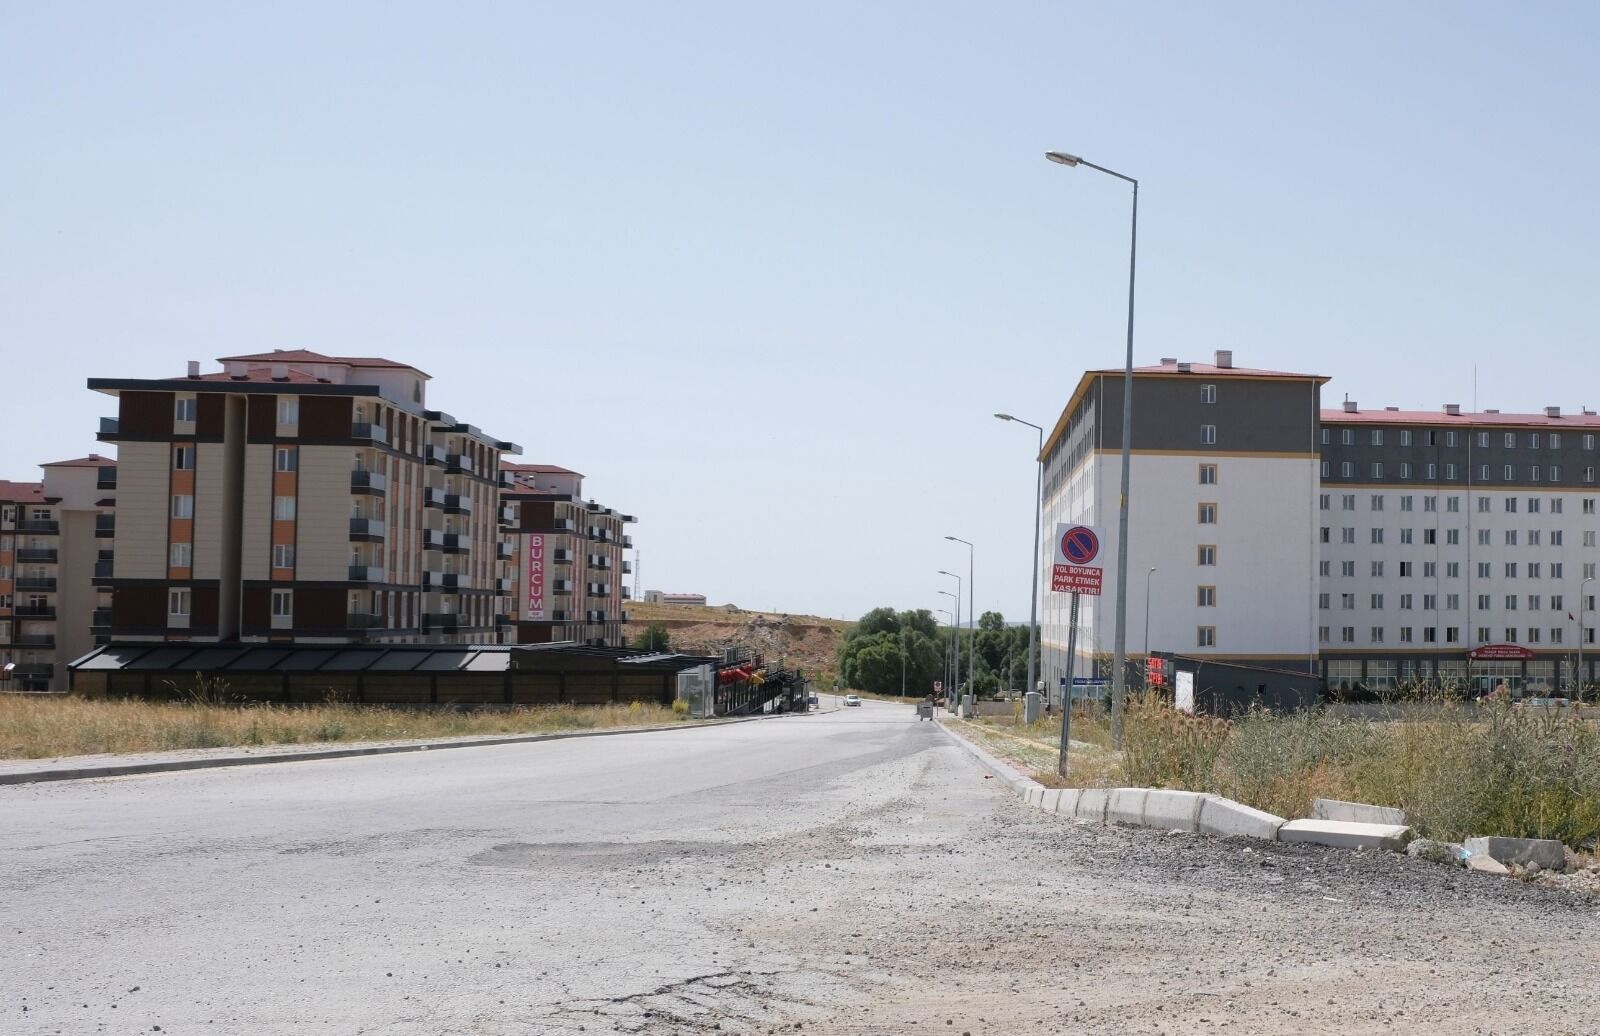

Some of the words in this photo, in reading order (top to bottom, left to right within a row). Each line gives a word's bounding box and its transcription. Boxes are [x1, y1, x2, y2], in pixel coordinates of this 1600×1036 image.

[529, 536, 543, 608] BURCUM
[1055, 565, 1069, 573] YOL
[1069, 567, 1101, 576] BOYUNCA
[1054, 575, 1074, 583] PARK
[1075, 577, 1100, 586] ETMEK
[1053, 584, 1100, 595] YASAKTIR!
